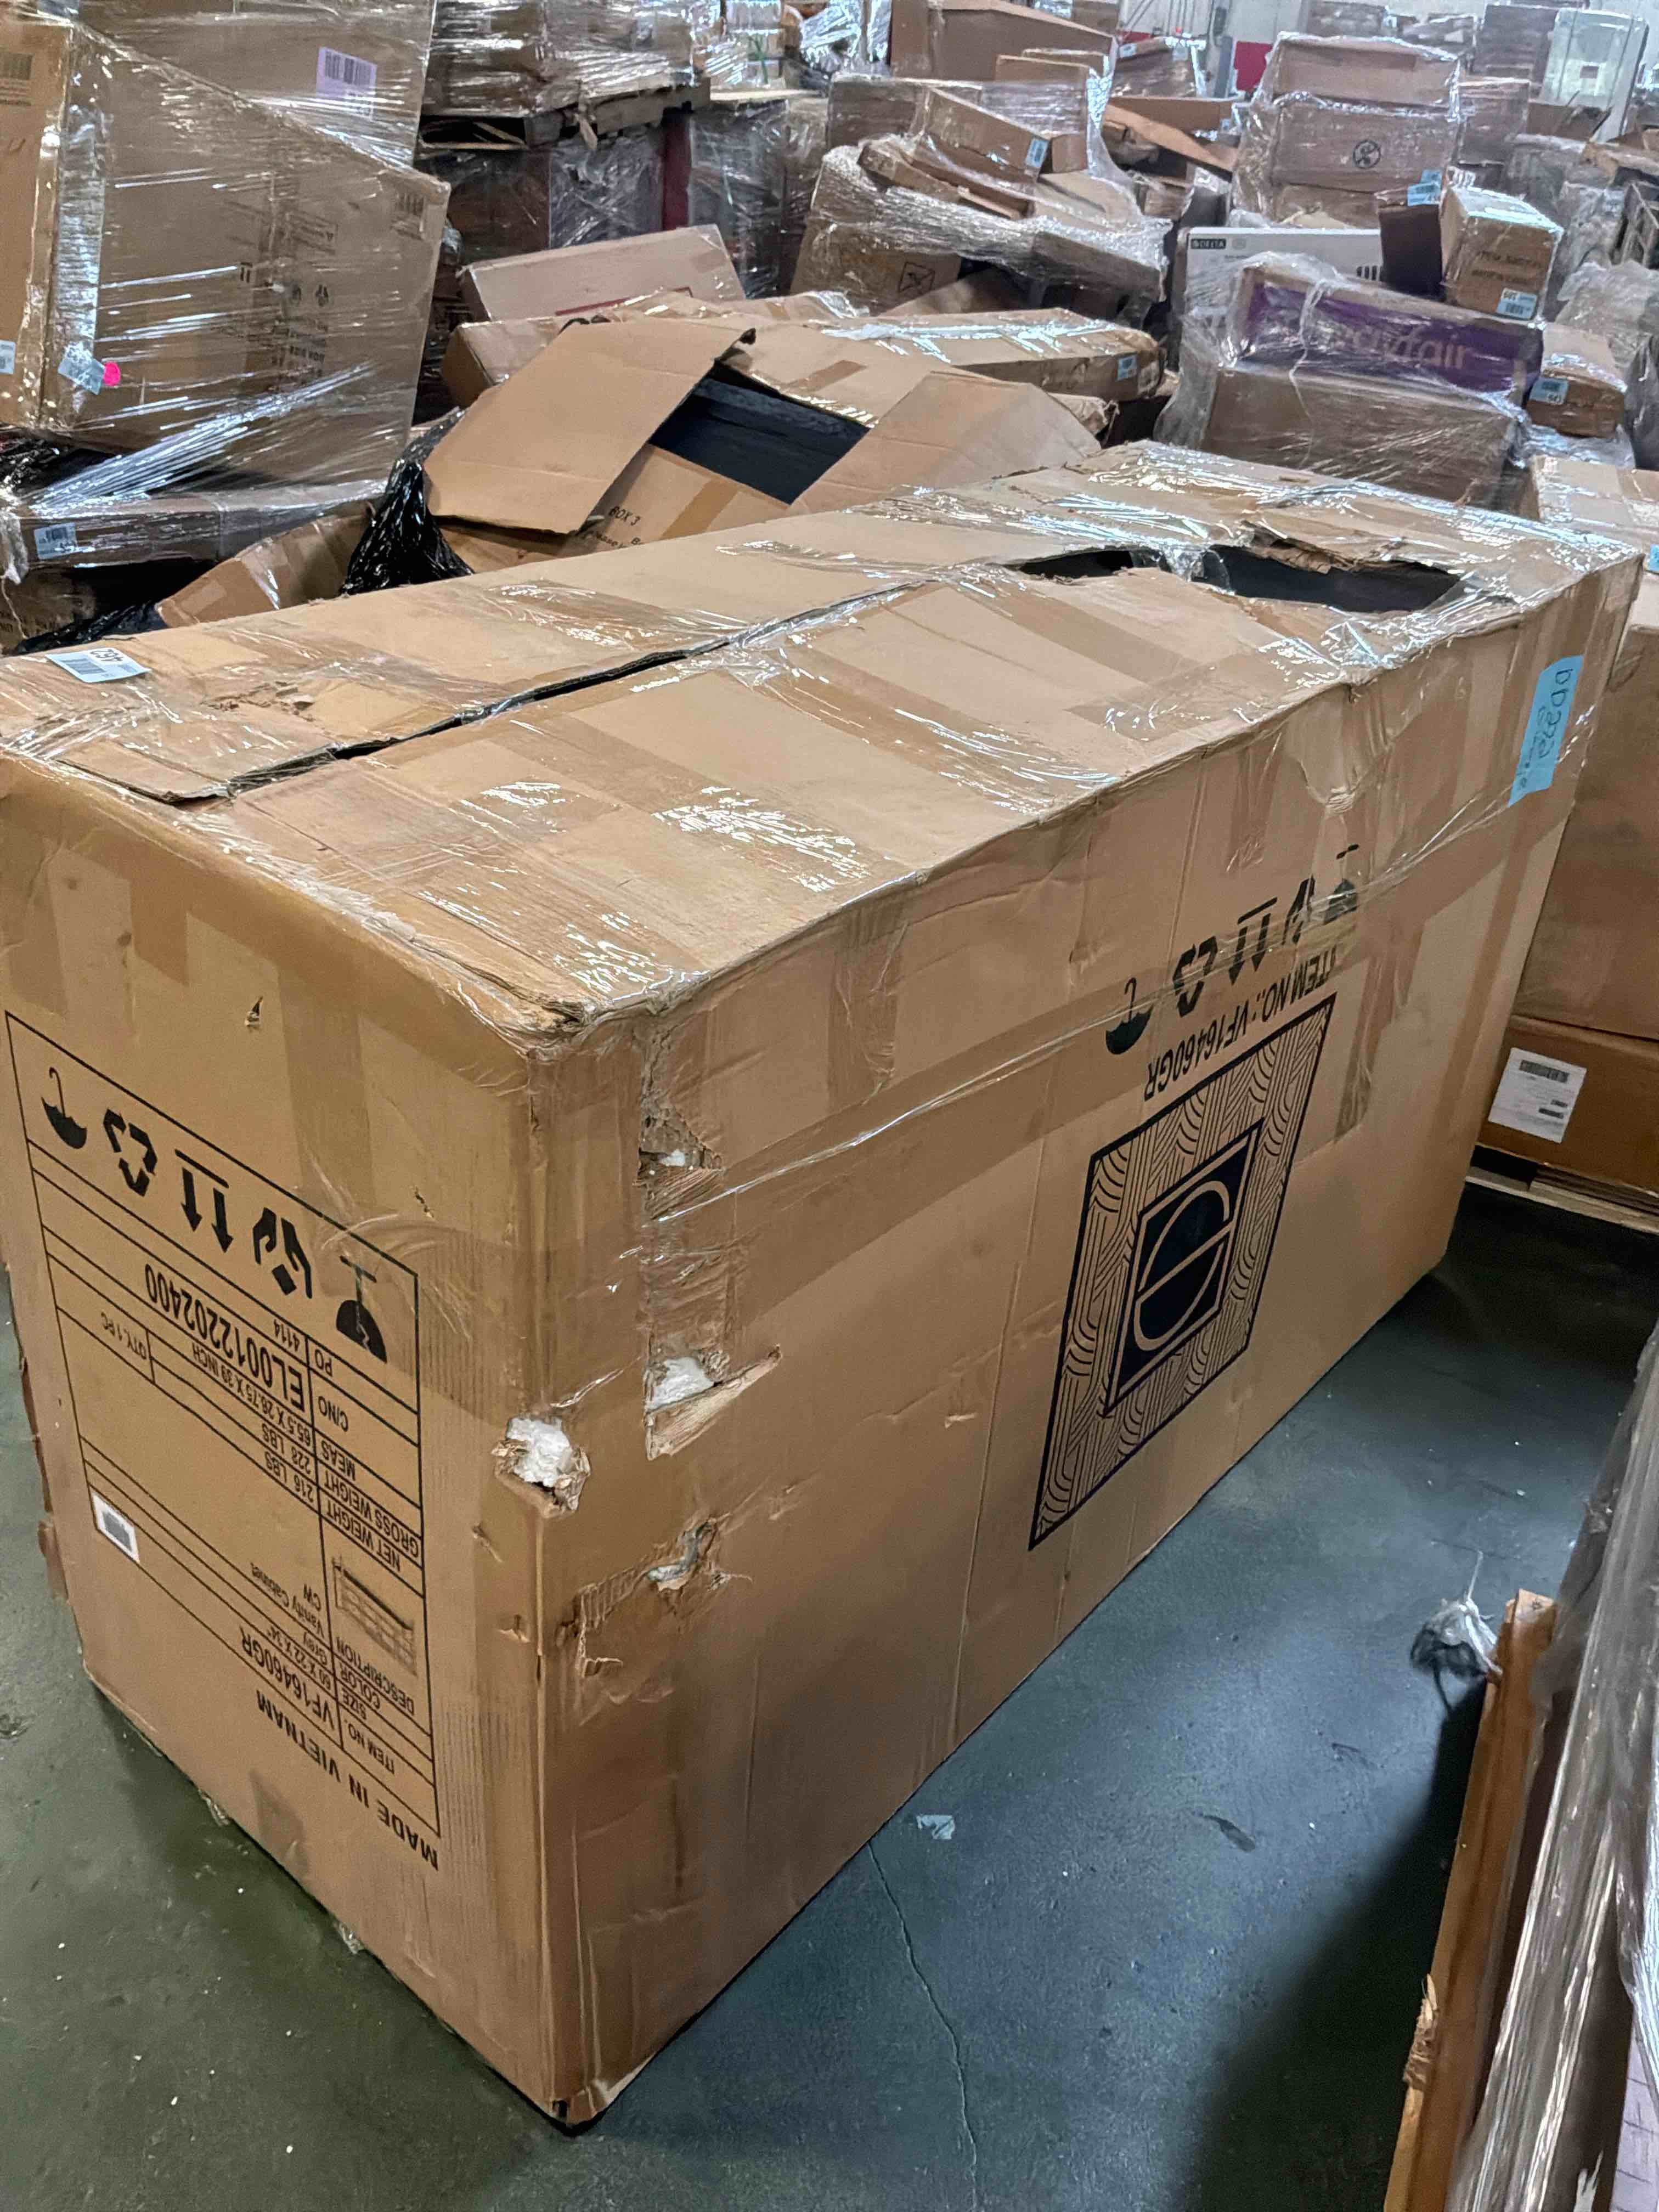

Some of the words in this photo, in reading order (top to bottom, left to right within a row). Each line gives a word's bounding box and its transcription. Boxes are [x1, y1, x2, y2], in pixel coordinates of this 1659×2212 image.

[608, 506, 633, 523] BOX
[630, 516, 641, 526] 3
[1291, 945, 1338, 1003] ITEM
[1144, 1000, 1249, 1102] VF16460GR
[144, 1263, 305, 1413] EL0012202400
[273, 1319, 300, 1354] 4114
[191, 1341, 218, 1377] INCH
[314, 1346, 332, 1377] PO
[235, 1374, 244, 1397] X
[276, 1406, 285, 1429] X
[287, 1417, 311, 1446] 65.5
[318, 1393, 348, 1432] C/NO
[261, 1420, 284, 1455] LBS
[264, 1448, 287, 1483] LBS
[321, 1438, 356, 1481] MEAS
[293, 1471, 314, 1503] 216
[323, 1468, 371, 1519] WEIGHT
[325, 1497, 373, 1548] WEIGHT
[375, 1508, 419, 1560] GROSS
[376, 1536, 400, 1573] NET
[250, 1561, 290, 1607] Cabinet
[303, 1582, 321, 1613] CW
[292, 1595, 324, 1639] Vanity
[239, 1626, 334, 1730] VF16460GR
[336, 1635, 414, 1714] DESCRIPTION
[339, 1661, 380, 1709] COLOR
[341, 1686, 366, 1720] SIZE
[256, 1689, 340, 1784] VIETNAM
[344, 1718, 364, 1748] NO.
[368, 1737, 394, 1776] ITEM
[348, 1773, 368, 1809] IN
[377, 1798, 438, 1871] MADE
